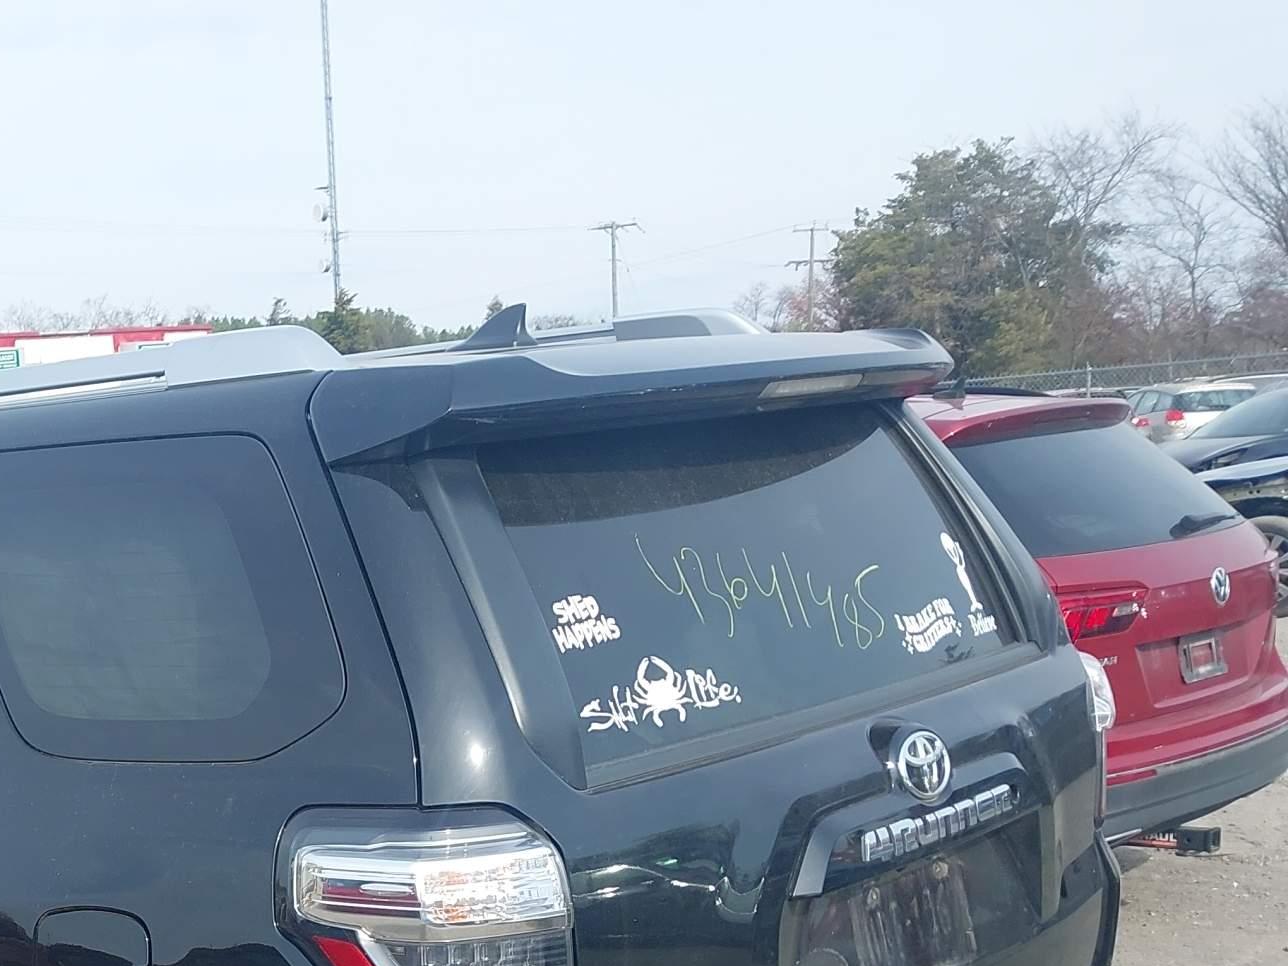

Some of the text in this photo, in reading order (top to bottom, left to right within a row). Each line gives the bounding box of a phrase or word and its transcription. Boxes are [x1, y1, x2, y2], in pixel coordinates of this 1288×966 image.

[552, 594, 600, 624] SHED
[635, 533, 885, 649] 43641485
[552, 614, 621, 654] HAPPENS
